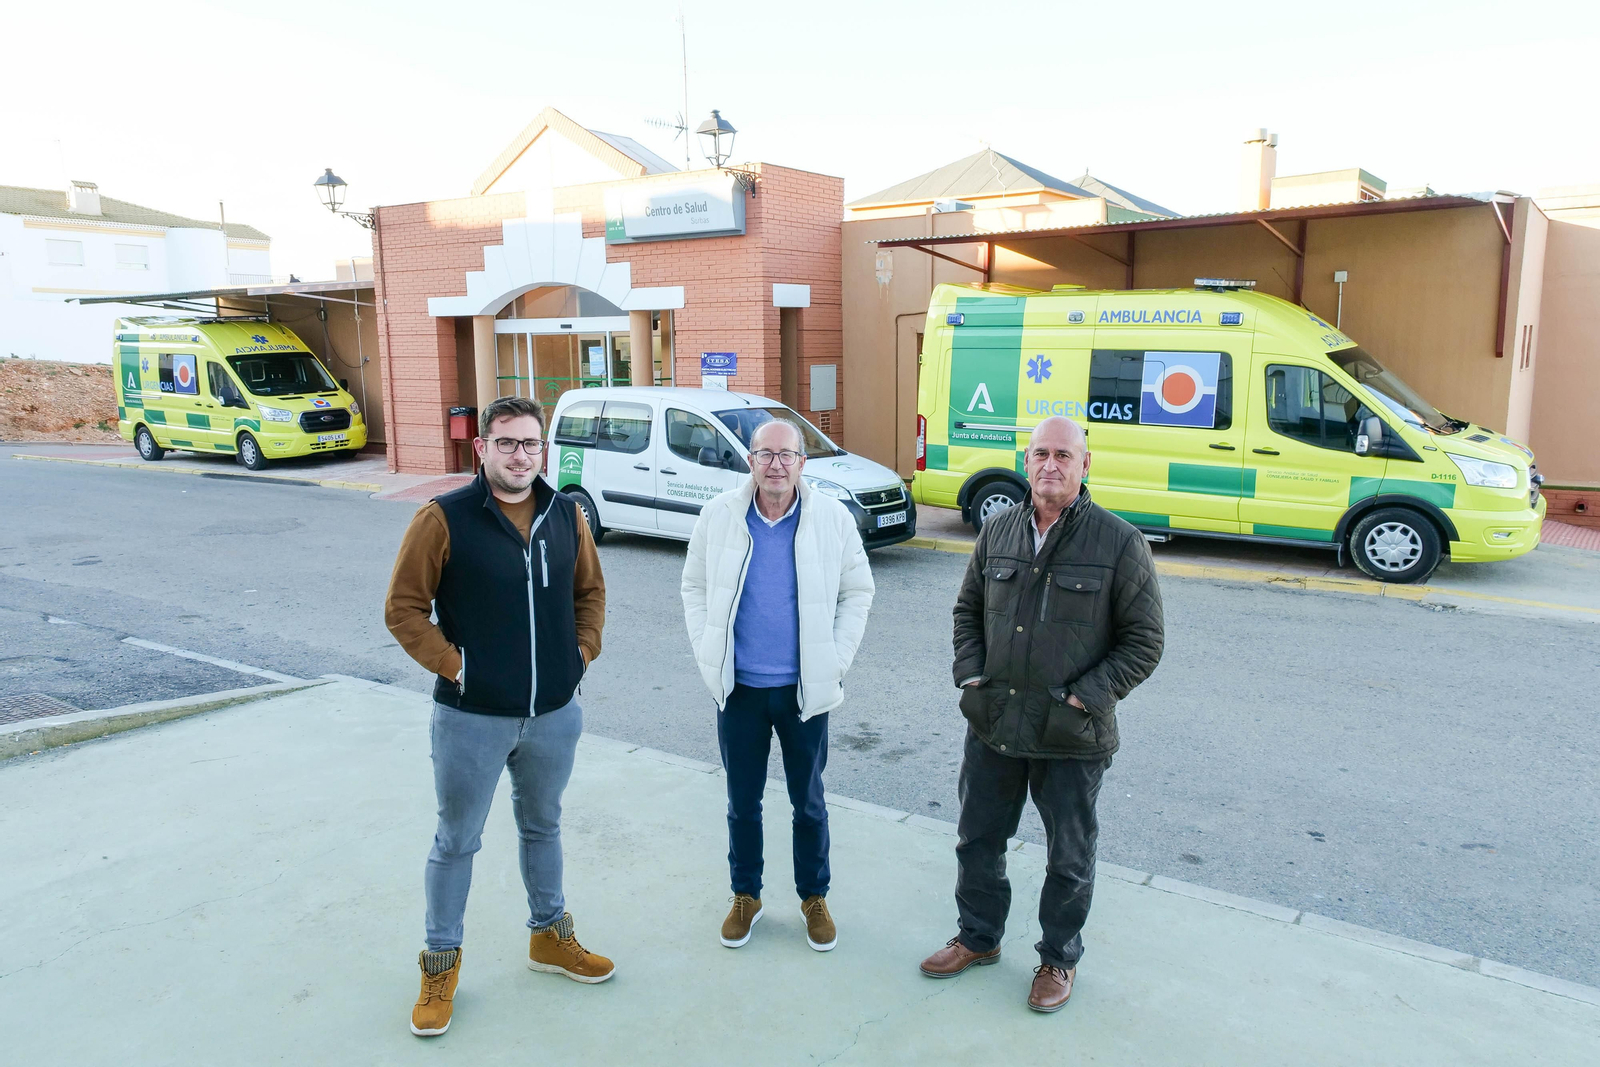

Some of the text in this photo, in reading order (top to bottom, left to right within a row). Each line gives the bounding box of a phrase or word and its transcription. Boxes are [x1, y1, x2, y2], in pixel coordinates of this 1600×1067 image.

[645, 200, 708, 217] Centro de Salud
[1098, 309, 1203, 324] AMBULANCIA
[143, 381, 174, 392] URGENCIAS
[1026, 399, 1133, 420] URGENCIAS
[980, 434, 1012, 442] Andalucía
[882, 512, 906, 526] 3396 KPB
